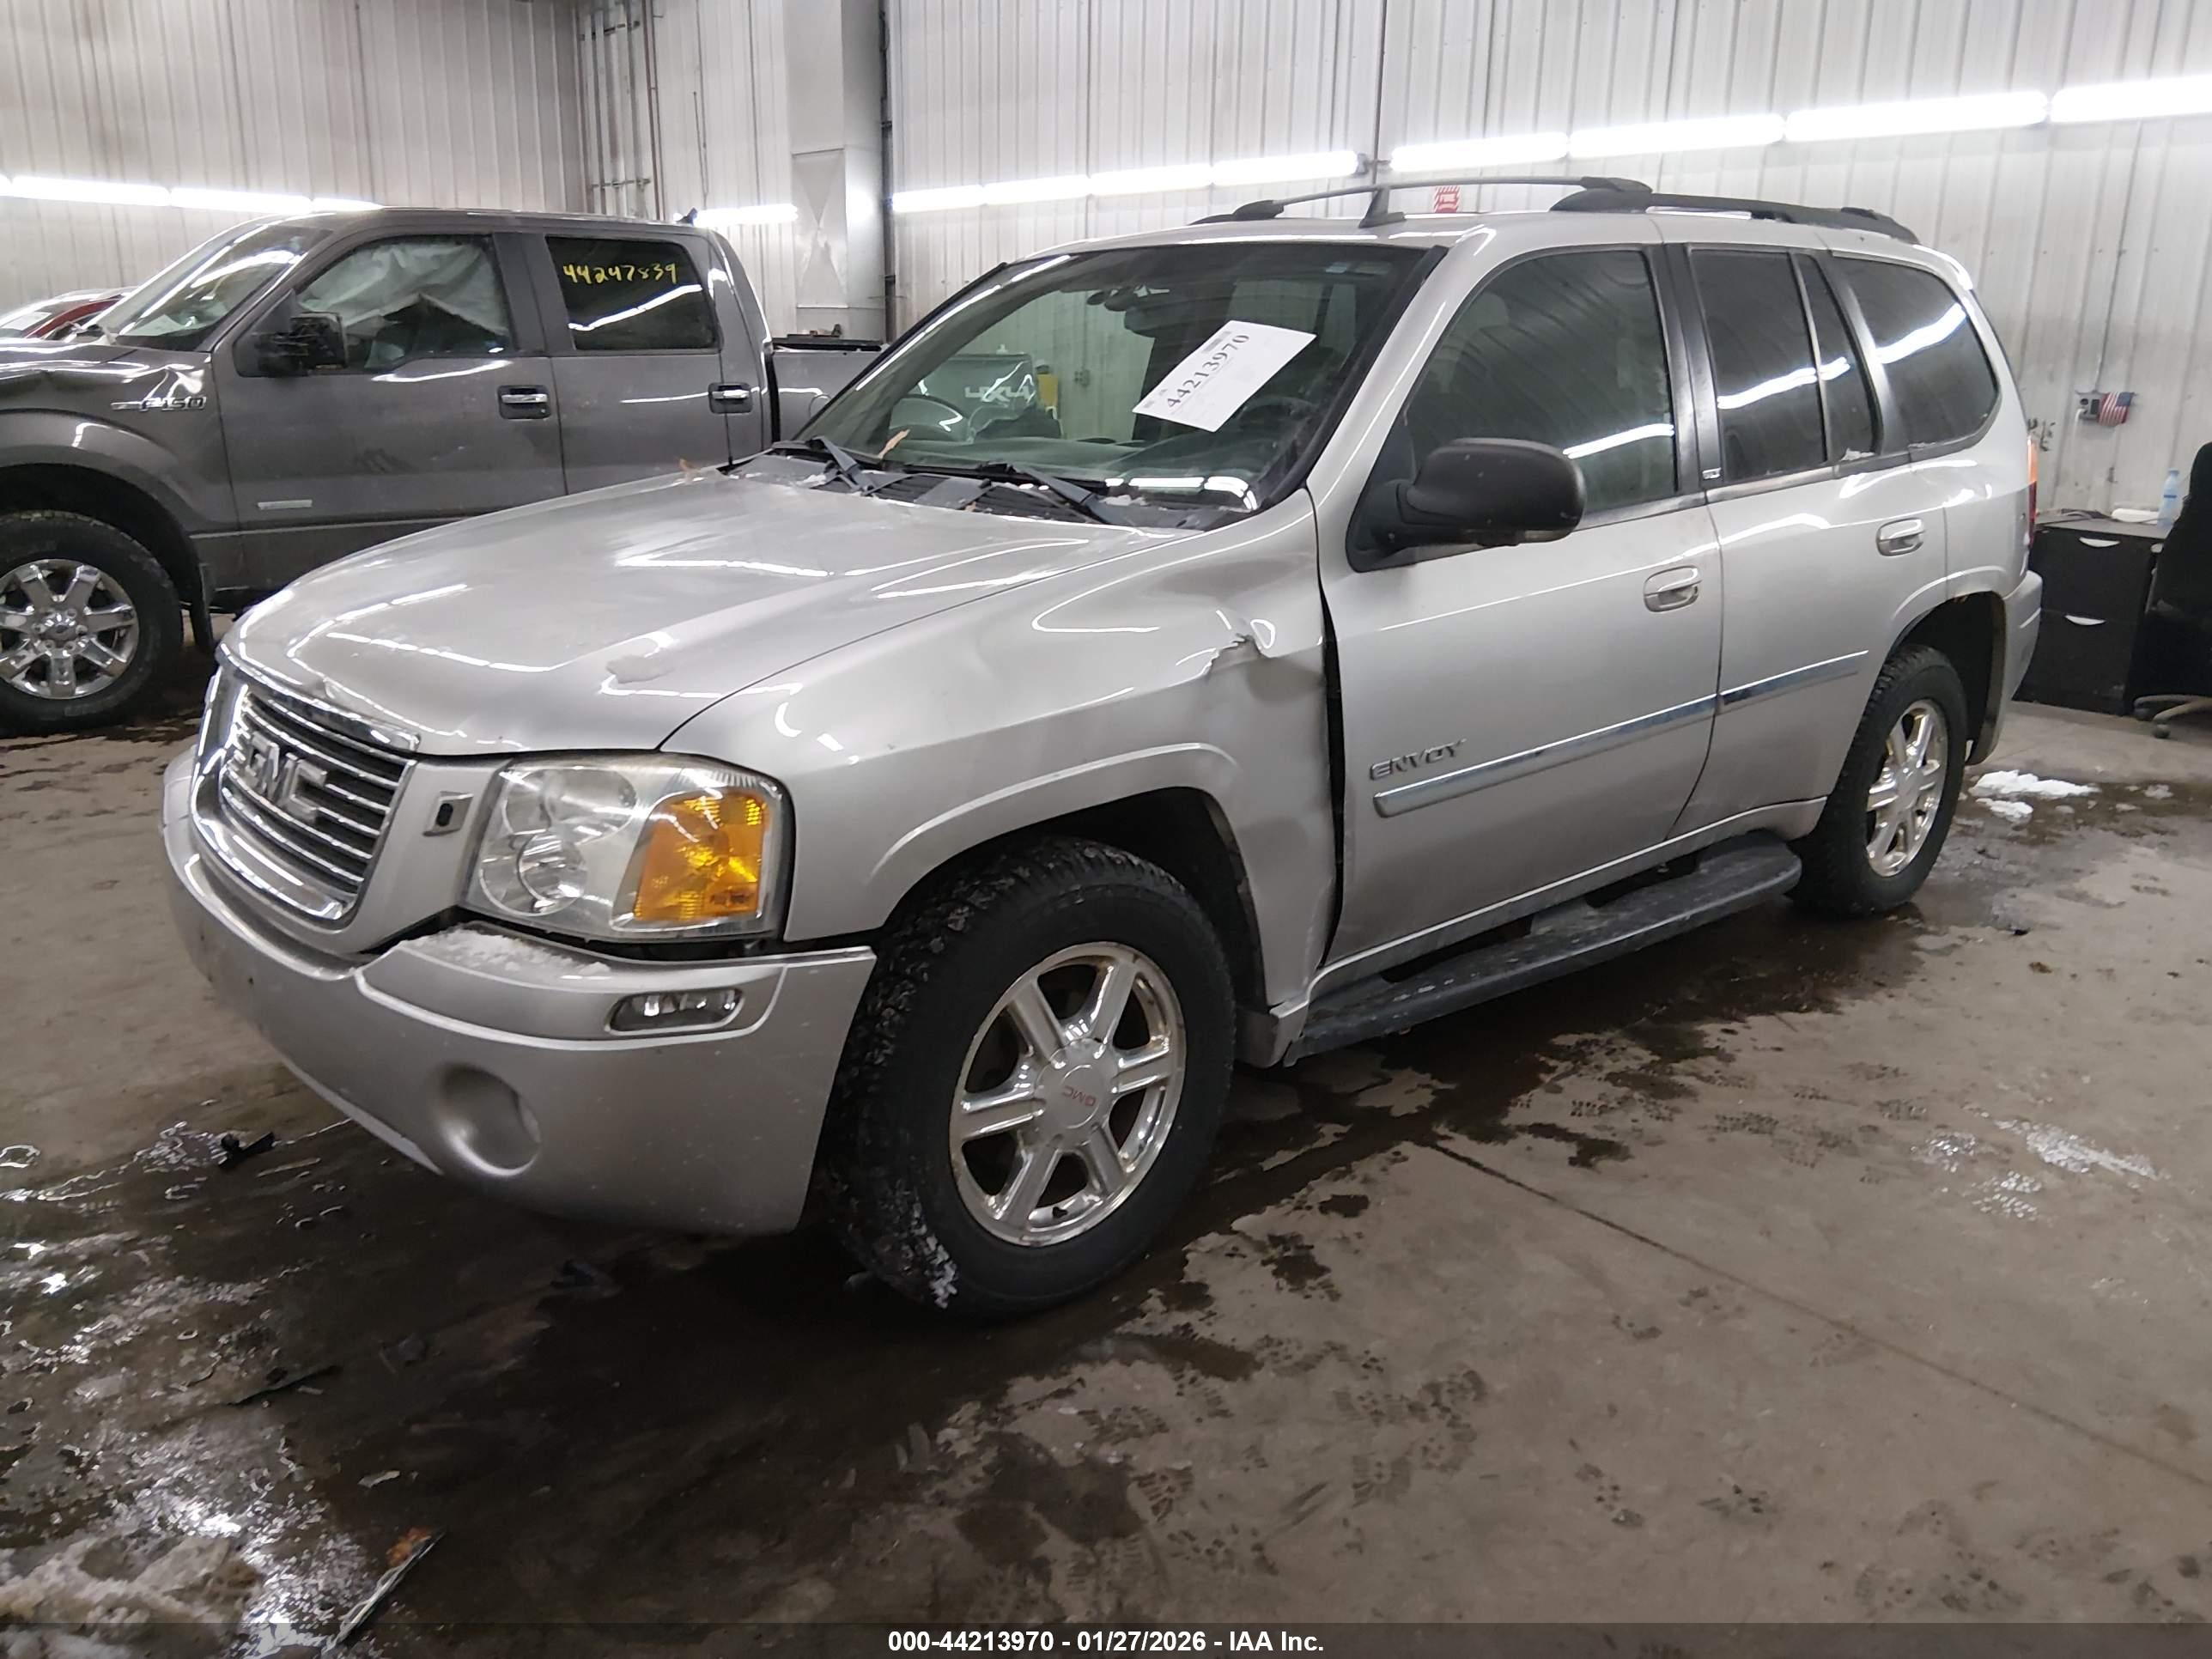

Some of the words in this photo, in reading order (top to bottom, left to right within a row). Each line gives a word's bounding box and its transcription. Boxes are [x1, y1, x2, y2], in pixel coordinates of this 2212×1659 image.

[563, 263, 677, 284] 44247839
[1166, 335, 1250, 408] 44213970
[1370, 738, 1467, 781] ENVOY
